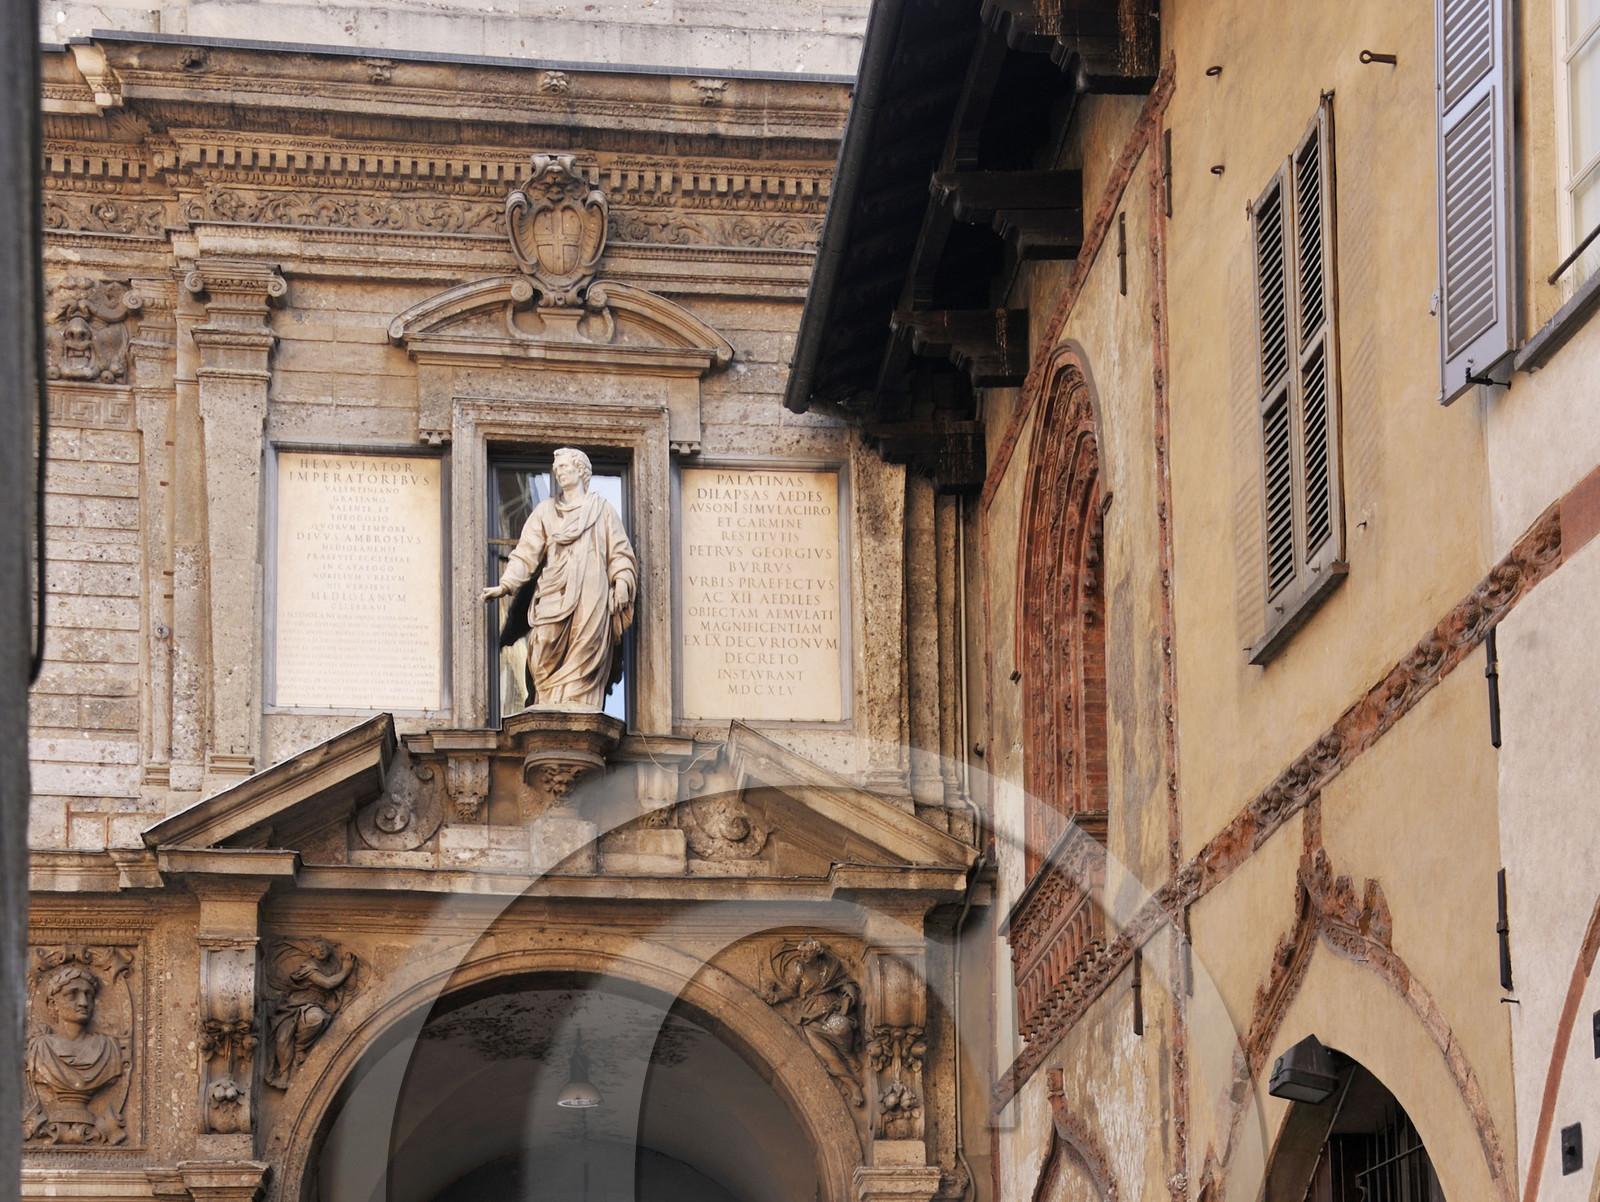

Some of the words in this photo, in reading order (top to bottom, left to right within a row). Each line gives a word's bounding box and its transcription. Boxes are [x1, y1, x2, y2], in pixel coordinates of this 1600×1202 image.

[300, 458, 342, 470] HEVS
[349, 460, 413, 472] VIATOR
[289, 471, 431, 486] IMPERATORIBVS
[717, 474, 804, 488] PALATINAS
[326, 485, 399, 494] VALENTINIANO
[697, 488, 769, 501] DILAPSAS
[776, 490, 823, 502] AEDES
[688, 502, 738, 513] AVSONI
[742, 504, 832, 516] SIMVLACHRO
[362, 525, 406, 533] TEMPORE
[717, 517, 732, 528] ET
[737, 518, 804, 529] CARMINE
[345, 534, 422, 544] AMBROSIVS
[721, 531, 800, 542] RESTITVTIS
[689, 544, 743, 557] PETRVS
[752, 547, 833, 560] GEORGIVS
[728, 562, 793, 574] BVRRVS
[688, 576, 734, 588] VRBIS
[739, 577, 835, 591] PRAEFECTVS
[311, 591, 406, 602] MEDIOLANVM
[702, 592, 724, 604] AC
[731, 591, 752, 604] XII
[760, 594, 821, 606] AEDILES
[688, 607, 759, 618] OBIECTAM
[766, 609, 834, 621] AEMVLATI
[700, 621, 823, 635] MAGNIFICENTIAM
[684, 635, 700, 647] EX
[705, 634, 722, 647] LX
[725, 636, 838, 650] DECVRIONVM
[725, 652, 799, 666] DECRETO
[717, 669, 805, 681] INSTAVRANT
[727, 684, 795, 696] MDCXLV
